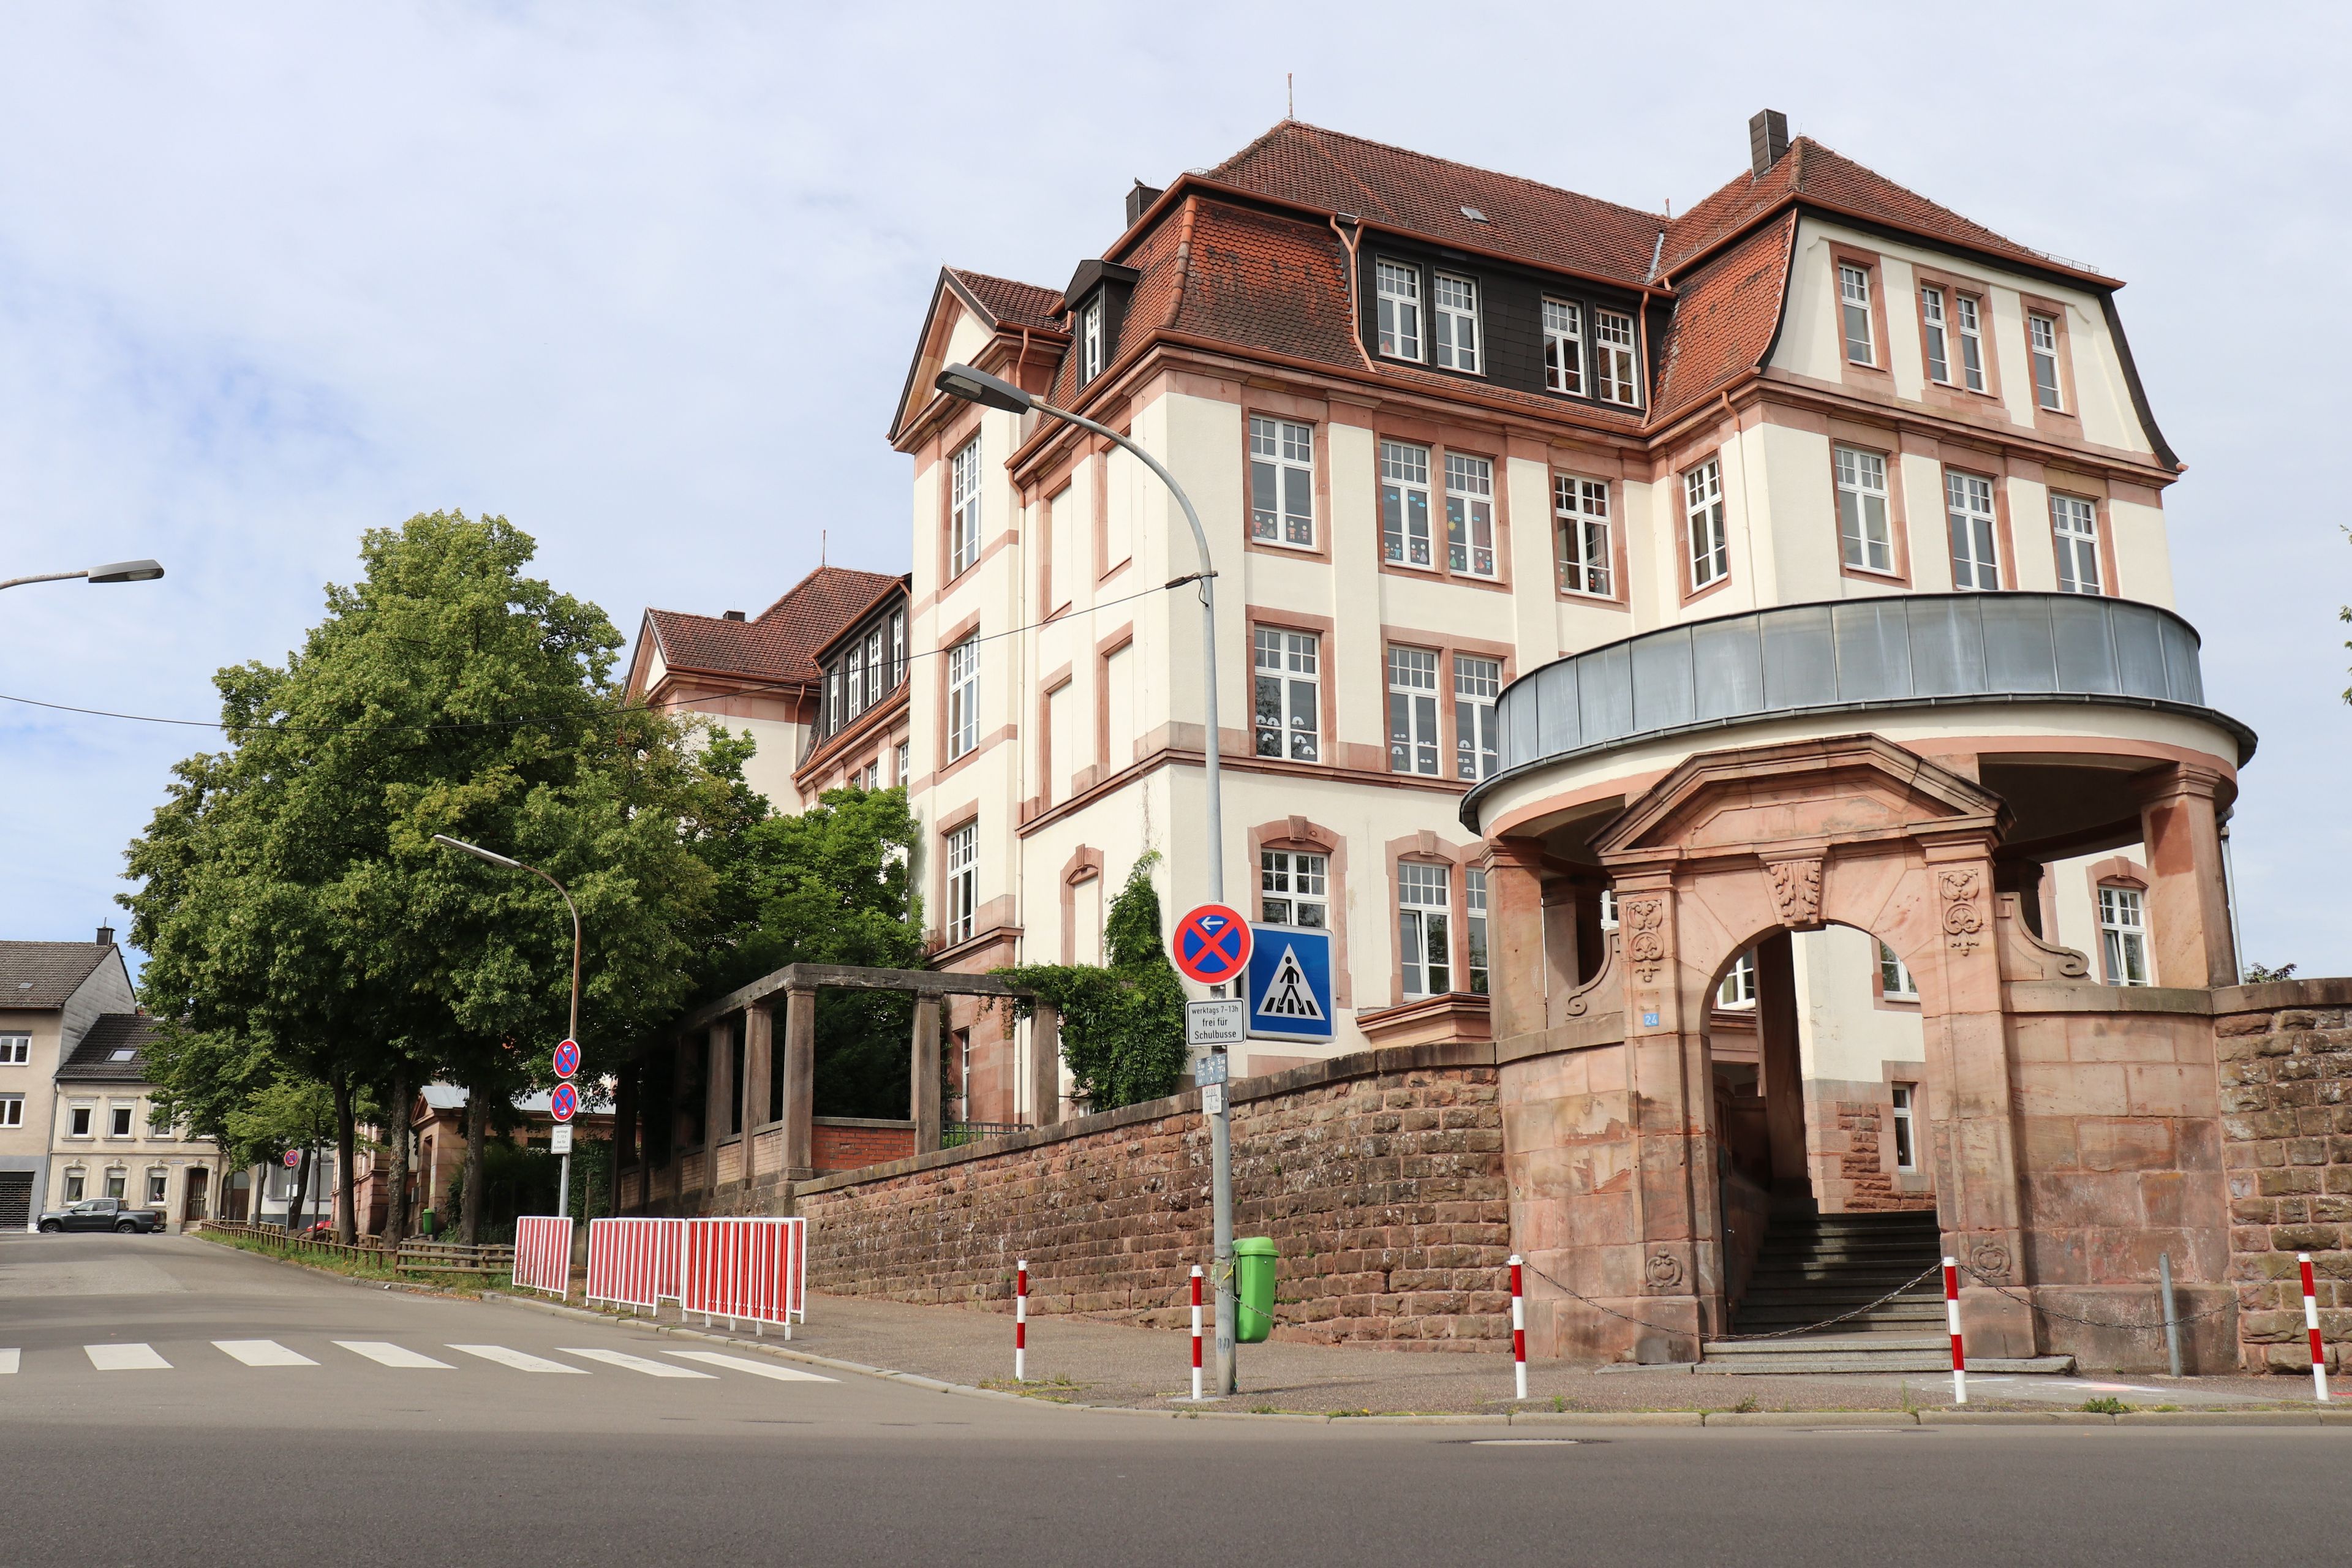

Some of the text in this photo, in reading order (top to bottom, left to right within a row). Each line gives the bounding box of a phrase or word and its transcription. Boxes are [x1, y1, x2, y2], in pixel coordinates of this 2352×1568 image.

[1191, 1006, 1219, 1016] werktags
[1202, 1017, 1228, 1027] frei für
[1645, 1014, 1657, 1025] 24
[1194, 1030, 1237, 1039] Schulbusse
